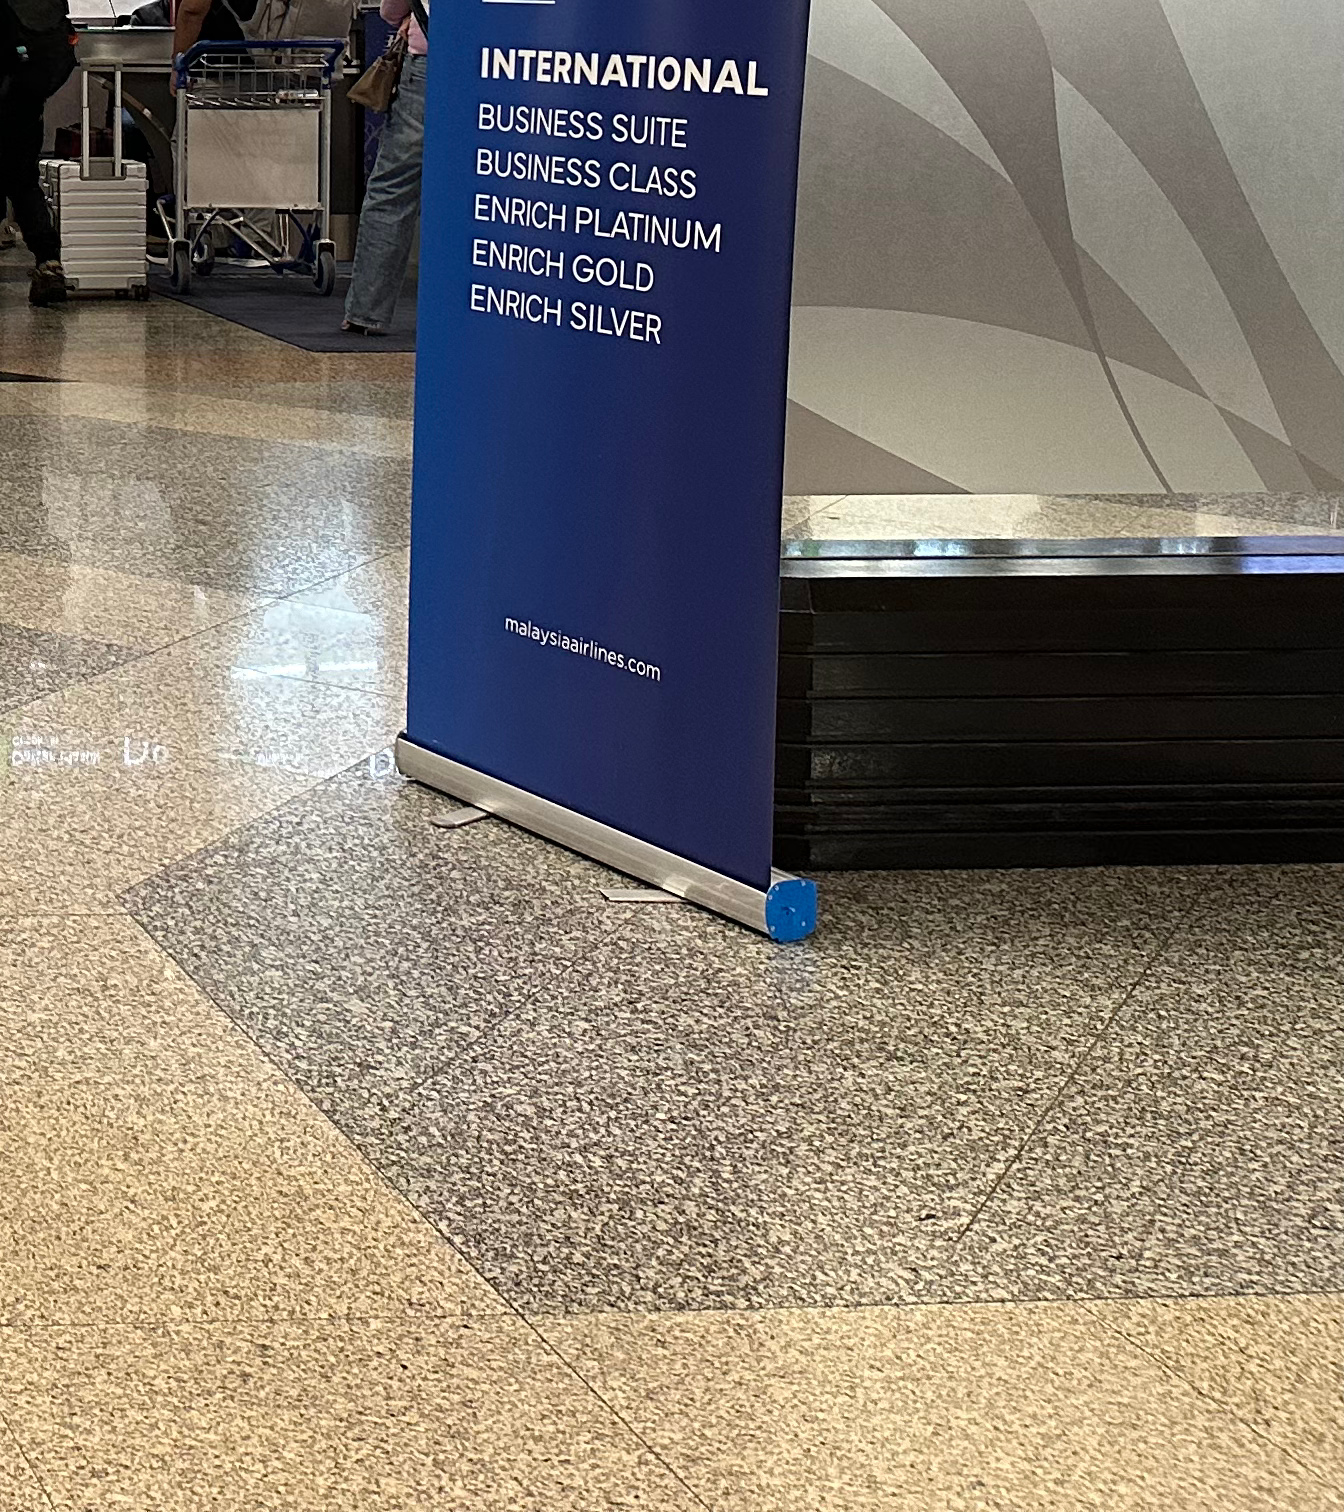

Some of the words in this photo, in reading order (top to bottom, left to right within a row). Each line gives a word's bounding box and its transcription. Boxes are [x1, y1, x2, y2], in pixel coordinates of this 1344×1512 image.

[480, 47, 768, 96] INTERNATIONAL
[479, 103, 603, 140] BUSINESS
[612, 114, 687, 148] SUITE
[477, 148, 601, 188] BUSINESS
[609, 162, 696, 199] CLASS
[474, 194, 566, 232] ENRICH
[575, 207, 721, 253] PLATINUM
[473, 239, 564, 279] ENRICH
[572, 255, 654, 292] GOLD
[471, 284, 561, 326] ENRICH
[570, 302, 662, 345] SILVER
[505, 616, 661, 681] malaysiaairlines.com
